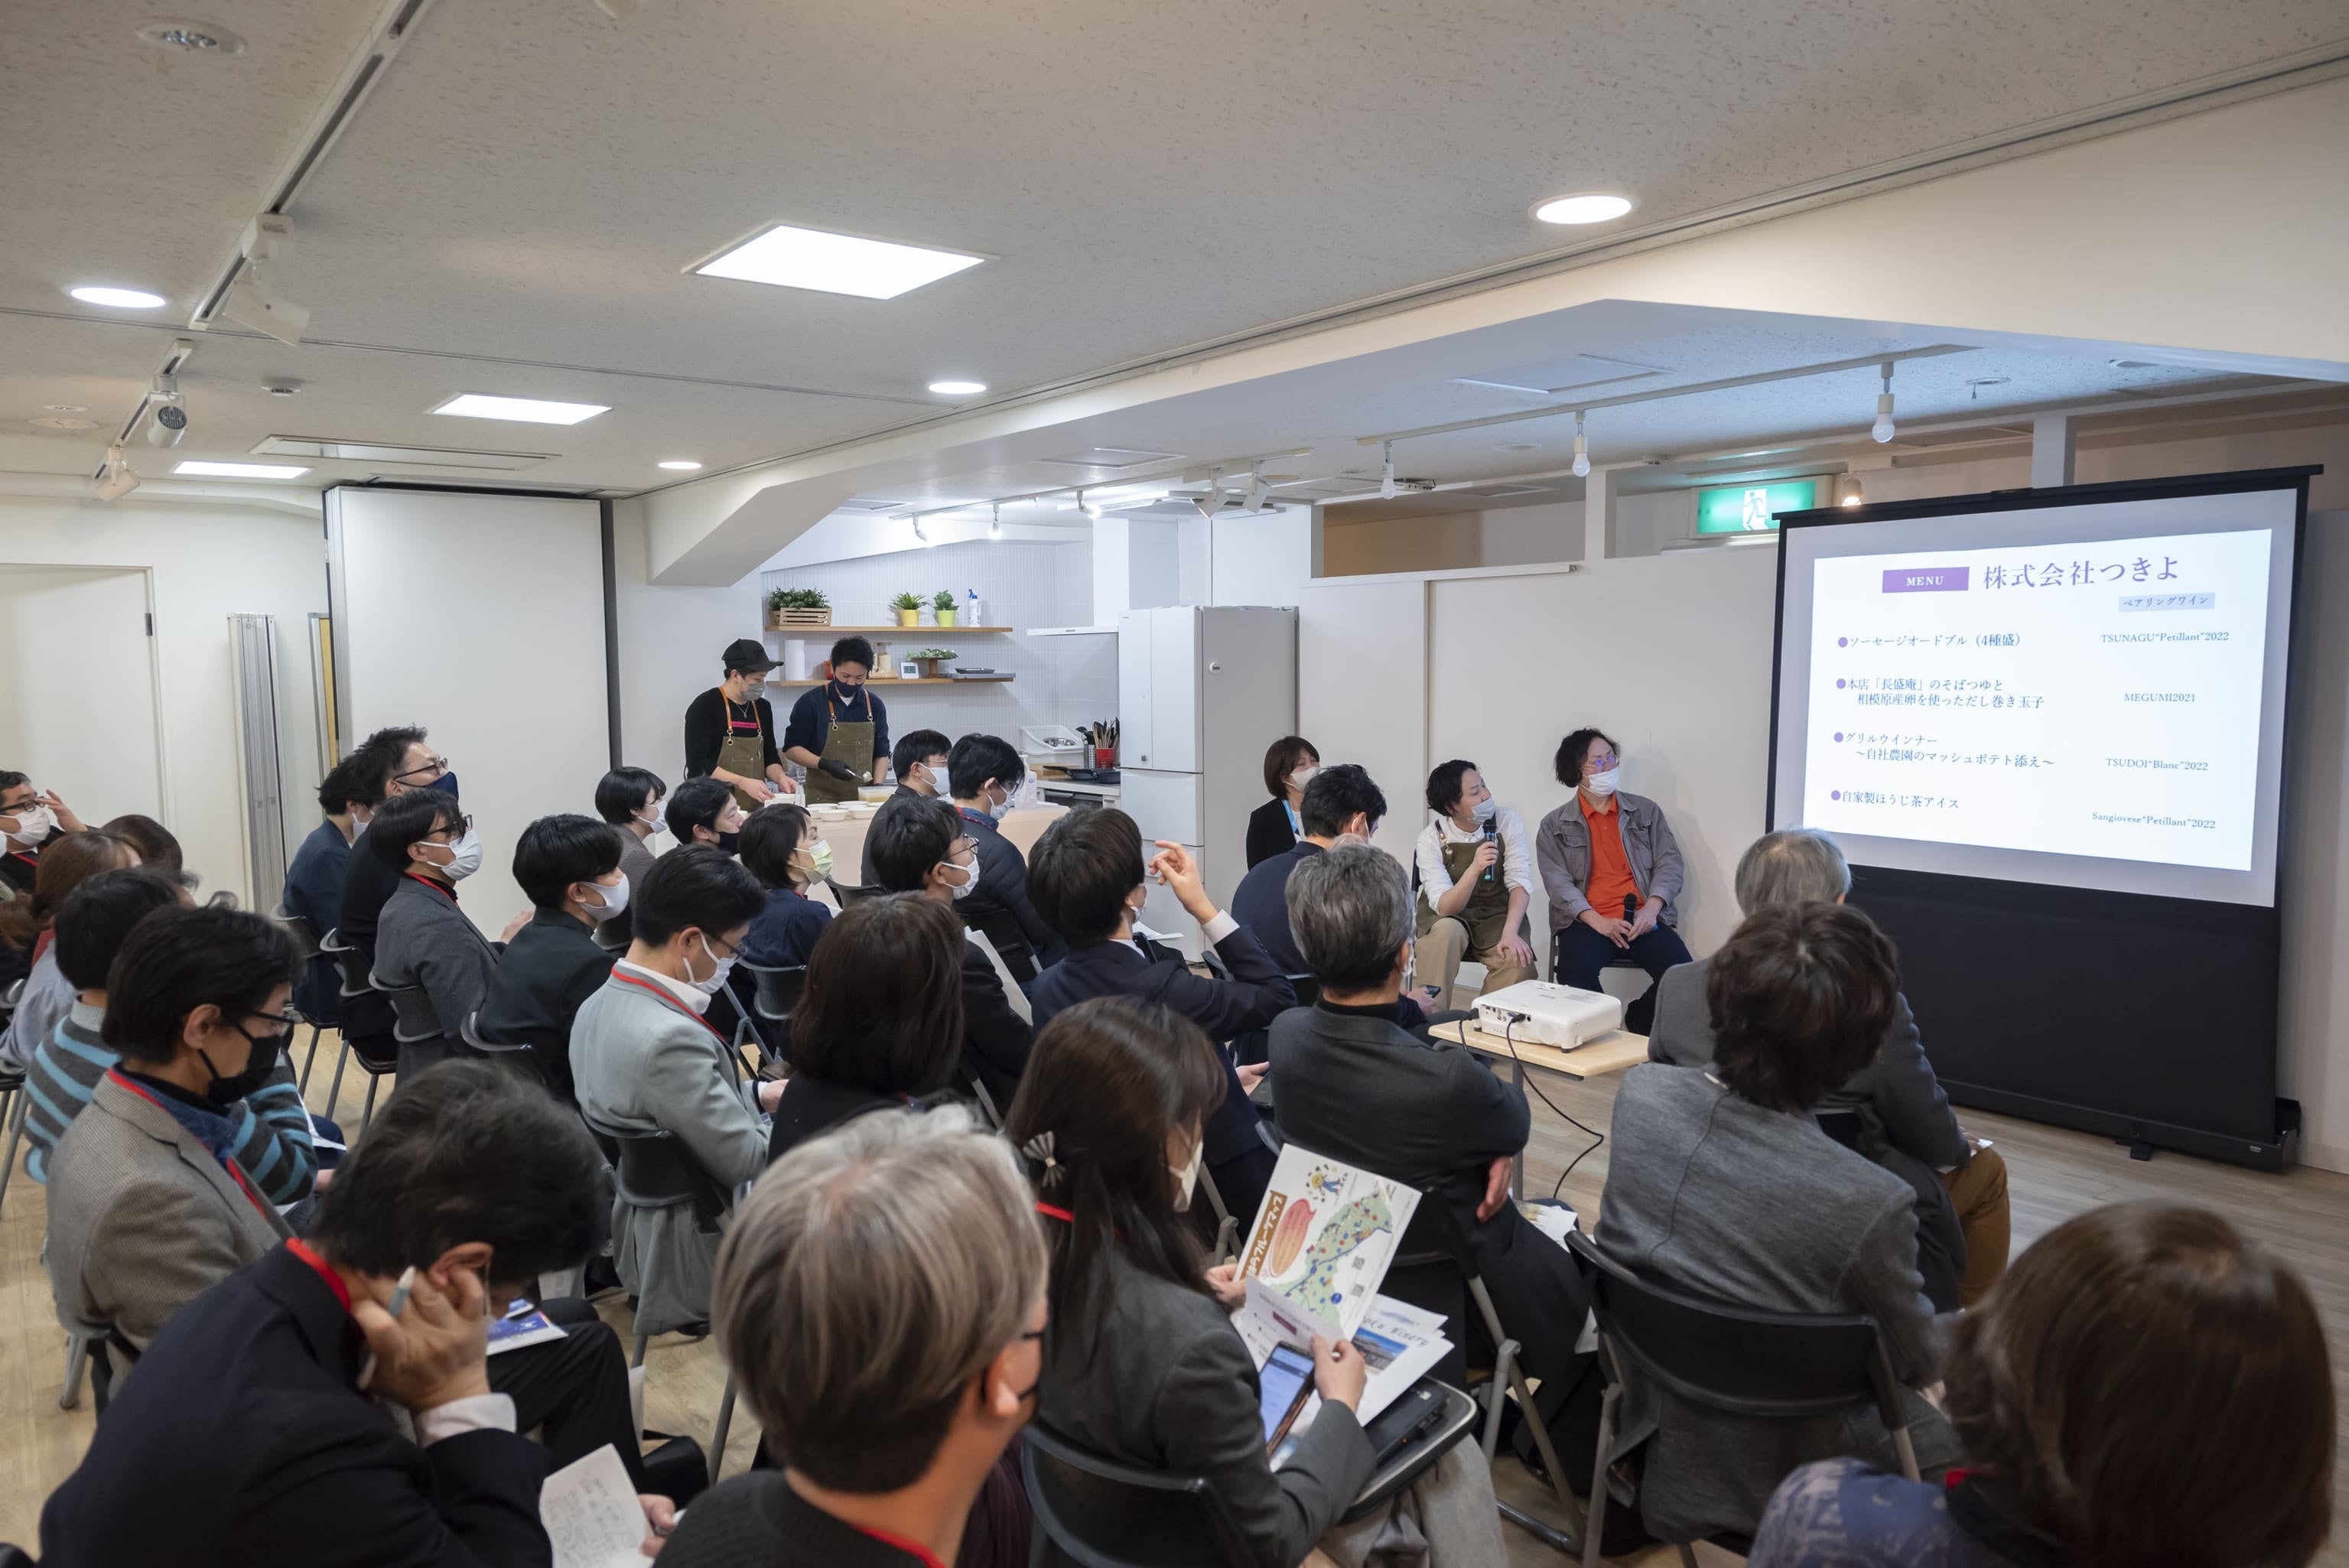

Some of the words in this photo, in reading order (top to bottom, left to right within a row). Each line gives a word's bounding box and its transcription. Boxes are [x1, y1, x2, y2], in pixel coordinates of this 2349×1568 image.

[1983, 555, 2179, 590] 株式会社つきよ
[1905, 575, 1945, 587] MENU
[1847, 678, 2003, 691] 本店「長盛庵」のそばつゆと
[1857, 692, 2045, 709] 相模原産卵を使っただし巻き玉子
[2124, 693, 2195, 702] MEGUMI2021
[1842, 789, 1960, 808] 自家製ほうじ茶アイス
